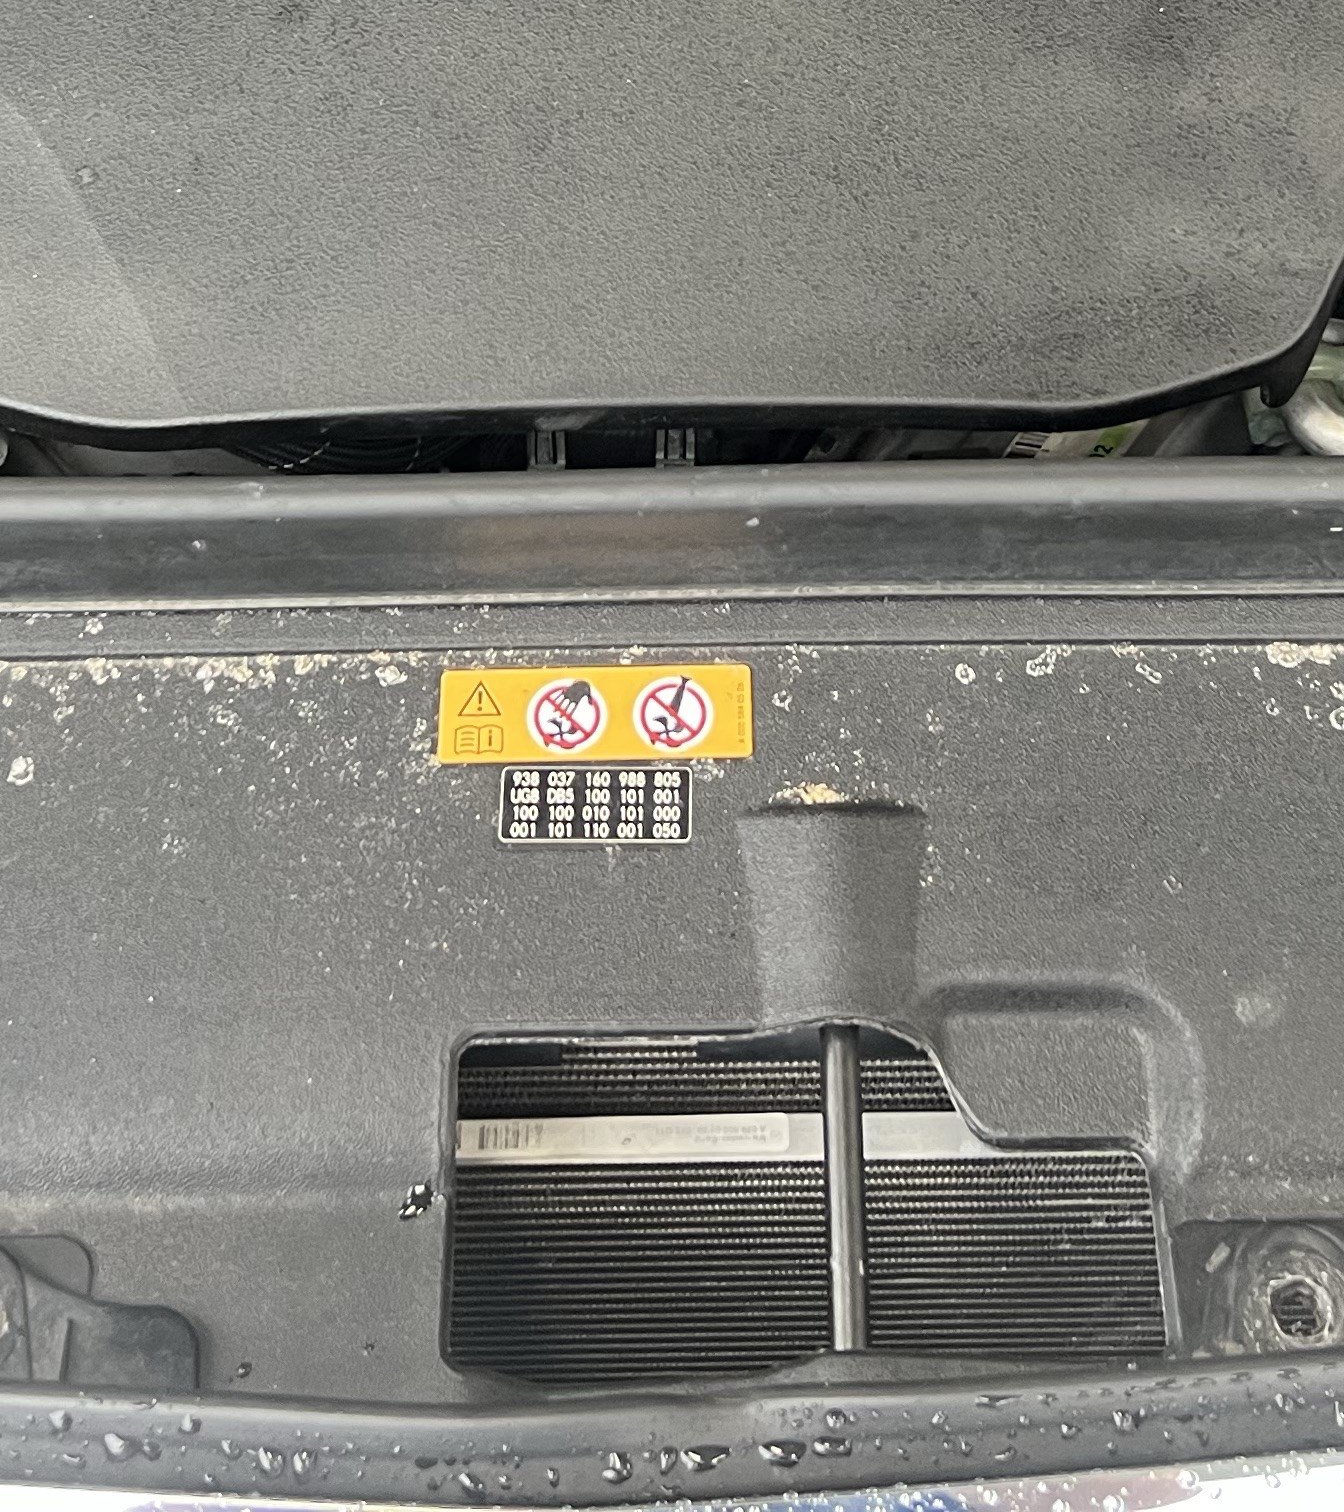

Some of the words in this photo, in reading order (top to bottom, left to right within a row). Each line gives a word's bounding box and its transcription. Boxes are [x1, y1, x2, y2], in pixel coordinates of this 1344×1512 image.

[512, 771, 540, 787] 938
[547, 771, 576, 787] 037
[585, 771, 611, 787] 160
[653, 771, 681, 788] 805
[585, 788, 611, 804] 100
[620, 788, 644, 805] 101
[653, 788, 680, 805] 001
[512, 805, 539, 821] 100
[548, 805, 575, 821] 100
[581, 805, 610, 821] 010
[620, 805, 644, 822] 101
[653, 805, 681, 822] 000
[509, 821, 536, 838] 001
[548, 822, 573, 838] 101
[583, 822, 610, 838] 110
[617, 822, 643, 838] 001
[652, 822, 681, 838] 050
